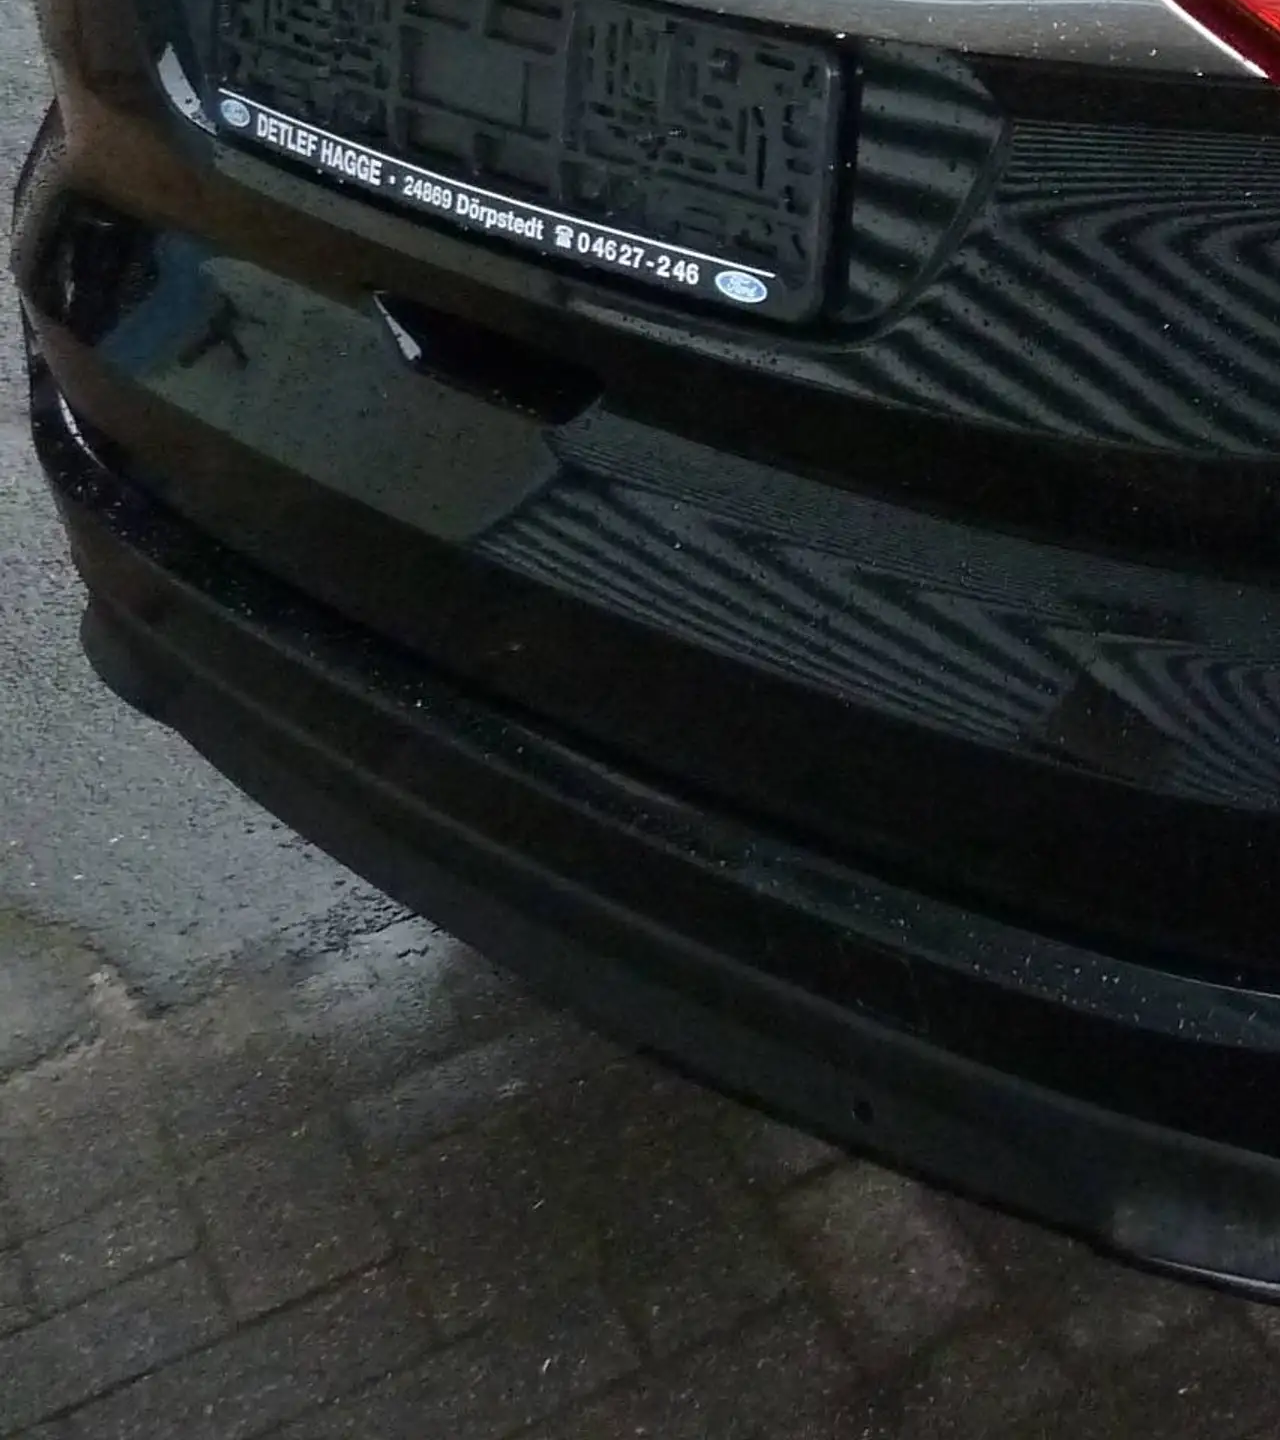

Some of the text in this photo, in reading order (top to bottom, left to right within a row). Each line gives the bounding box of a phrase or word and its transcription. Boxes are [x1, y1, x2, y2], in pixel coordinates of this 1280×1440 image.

[256, 112, 318, 158] DETLEF
[319, 138, 383, 186] HAGGE
[402, 175, 453, 210] 24869
[455, 192, 545, 241] Dörpstedt
[577, 231, 700, 285] 04627-246
